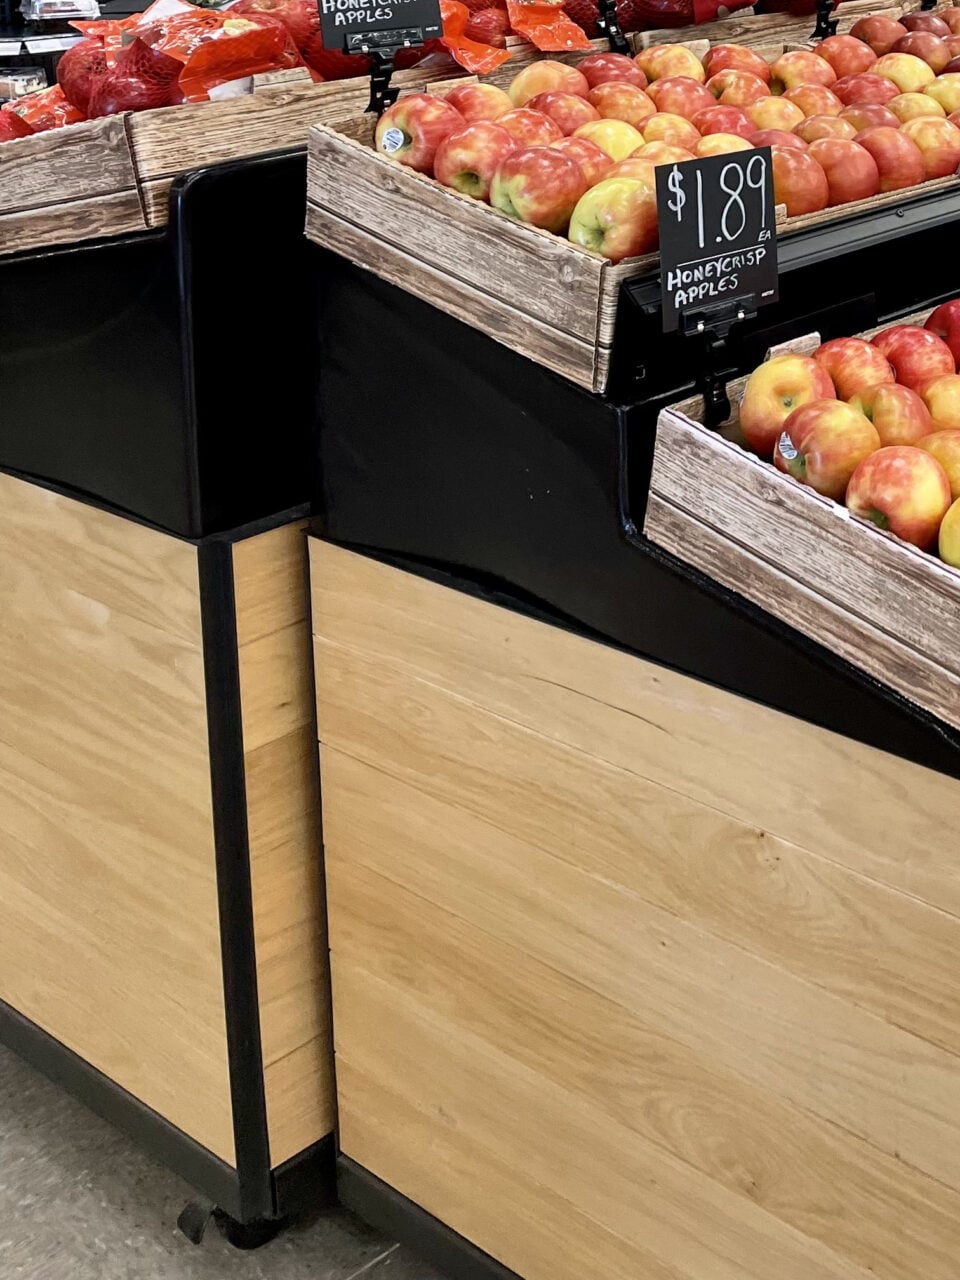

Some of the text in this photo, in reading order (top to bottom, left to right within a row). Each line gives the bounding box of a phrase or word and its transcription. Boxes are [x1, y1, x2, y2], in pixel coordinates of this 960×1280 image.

[334, 7, 393, 26] APPLES
[667, 155, 771, 248] $1.89 EA
[667, 248, 767, 291] HONEYCRISP
[674, 273, 738, 308] APPLES
